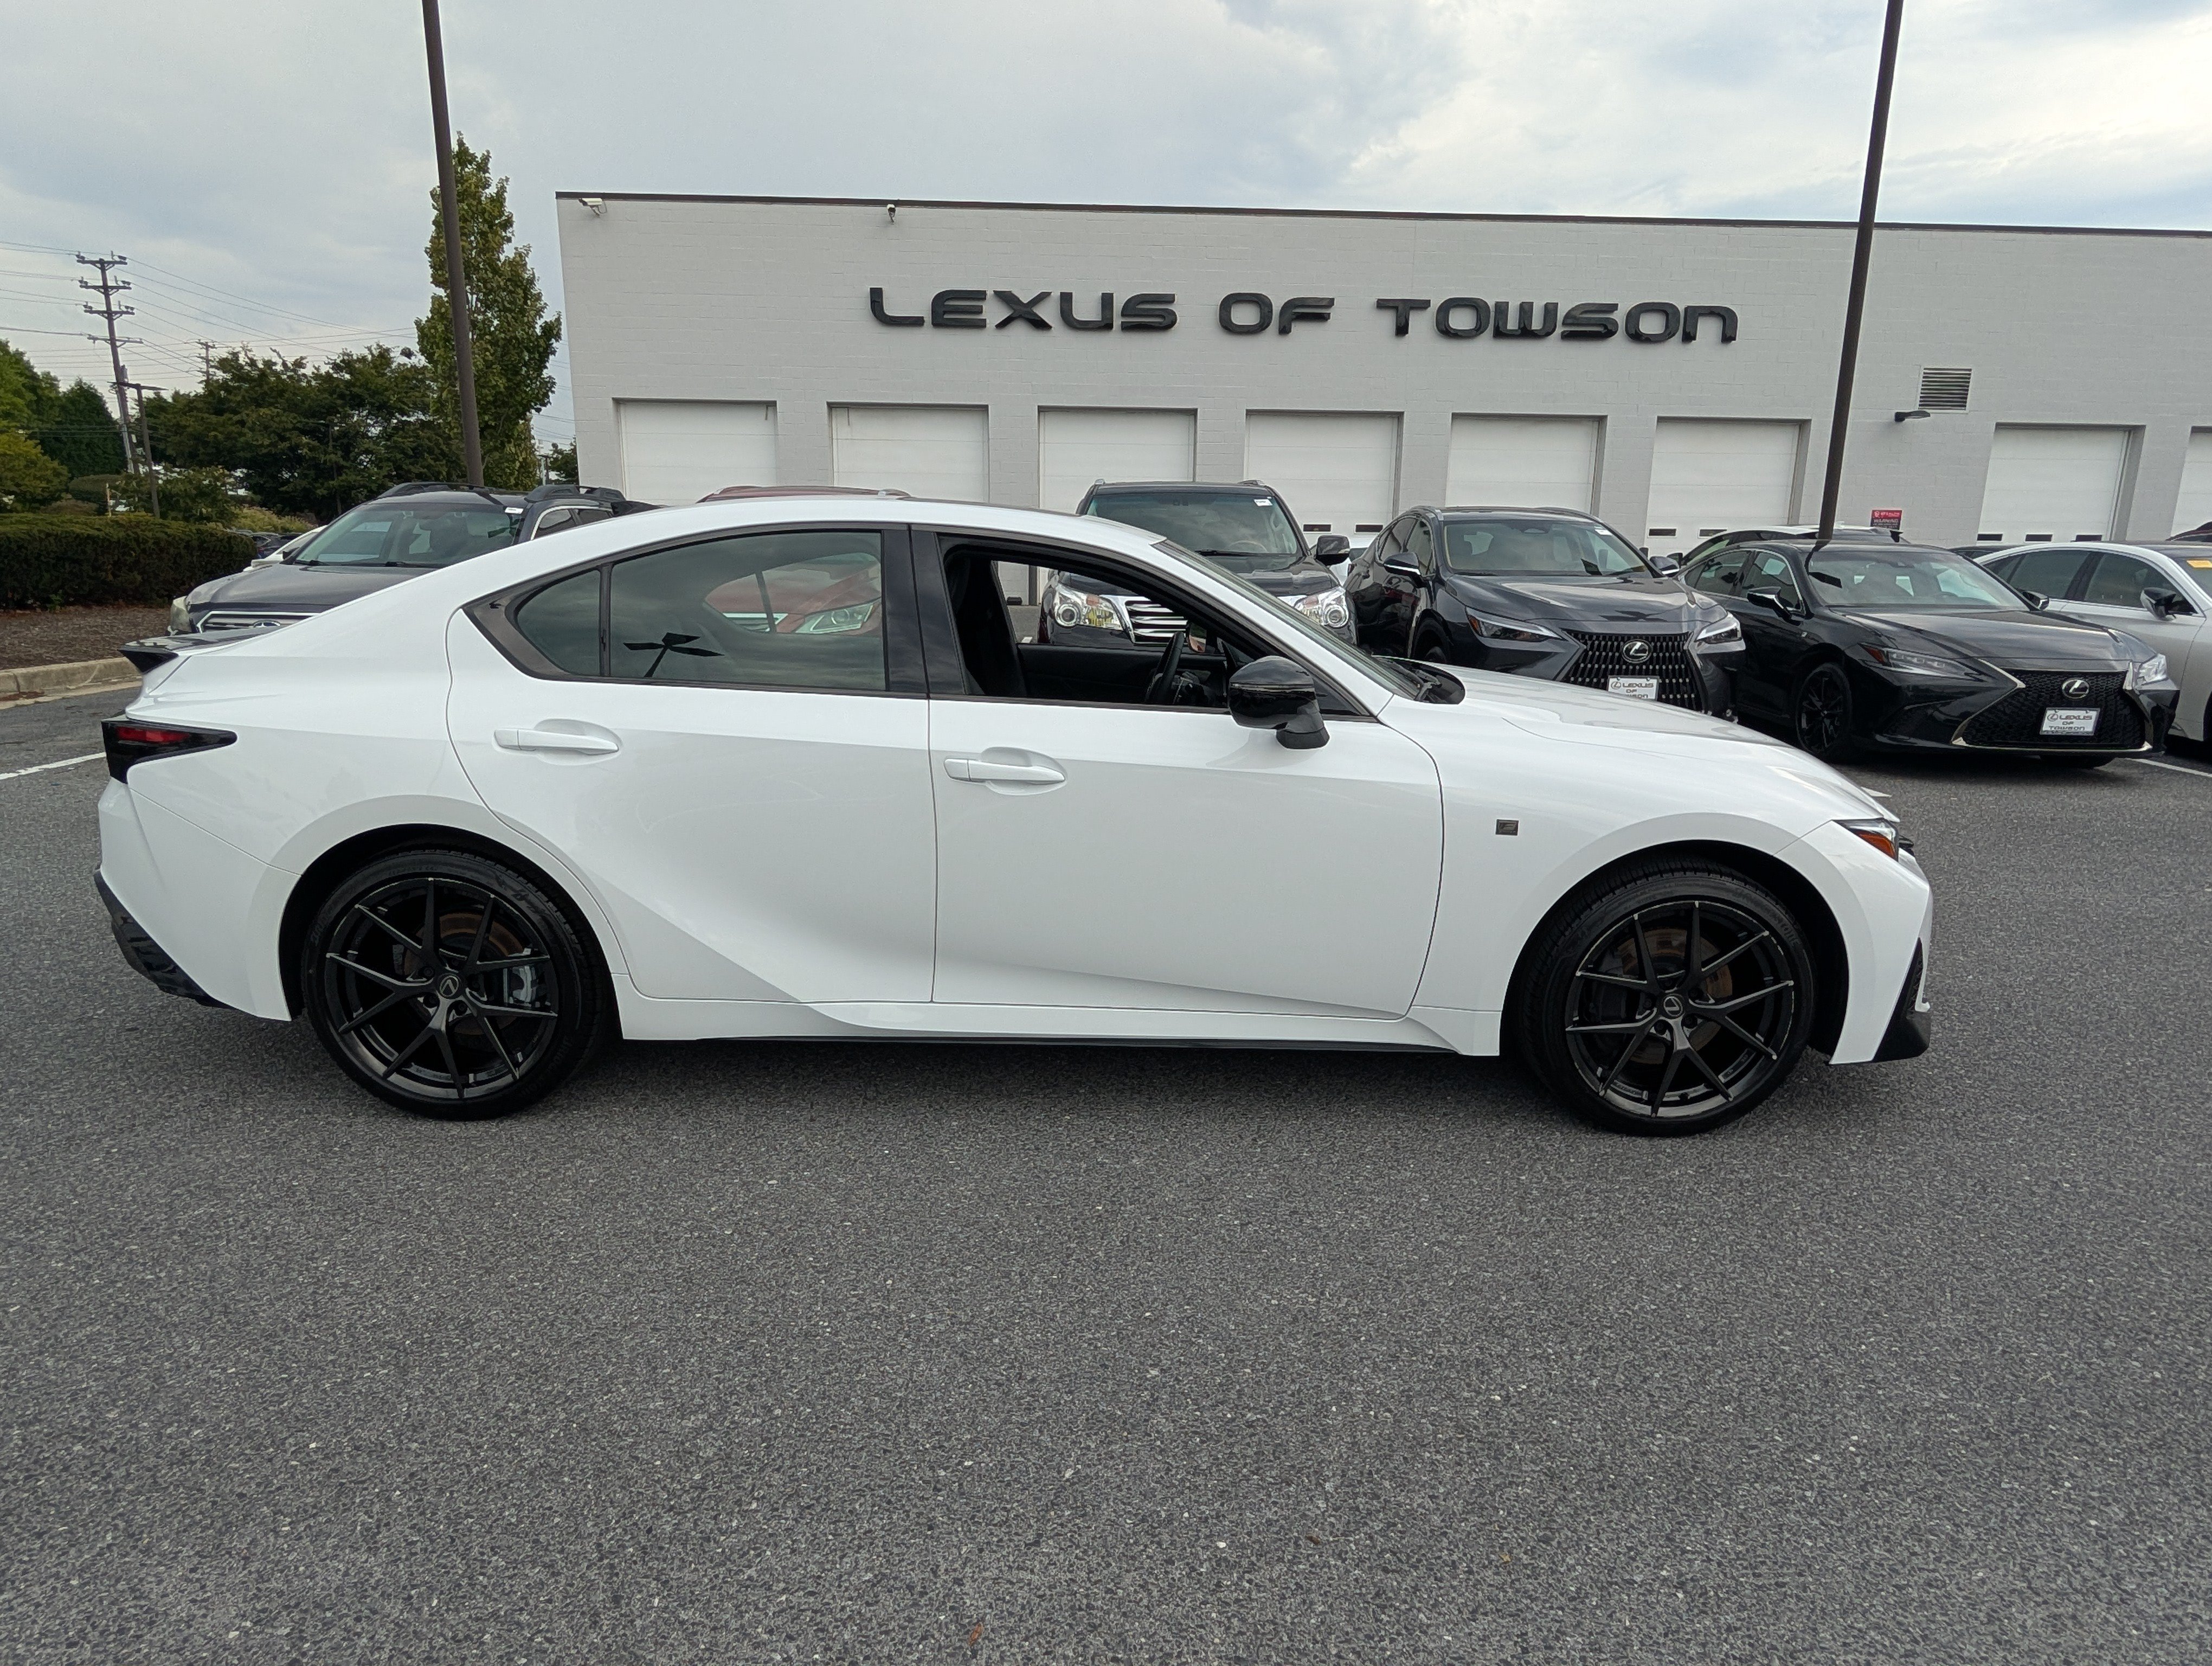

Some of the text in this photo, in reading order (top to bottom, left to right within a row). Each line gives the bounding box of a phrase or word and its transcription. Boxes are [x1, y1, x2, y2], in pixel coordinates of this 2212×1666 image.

[869, 286, 1739, 345] LEXUS OF TOWSON
